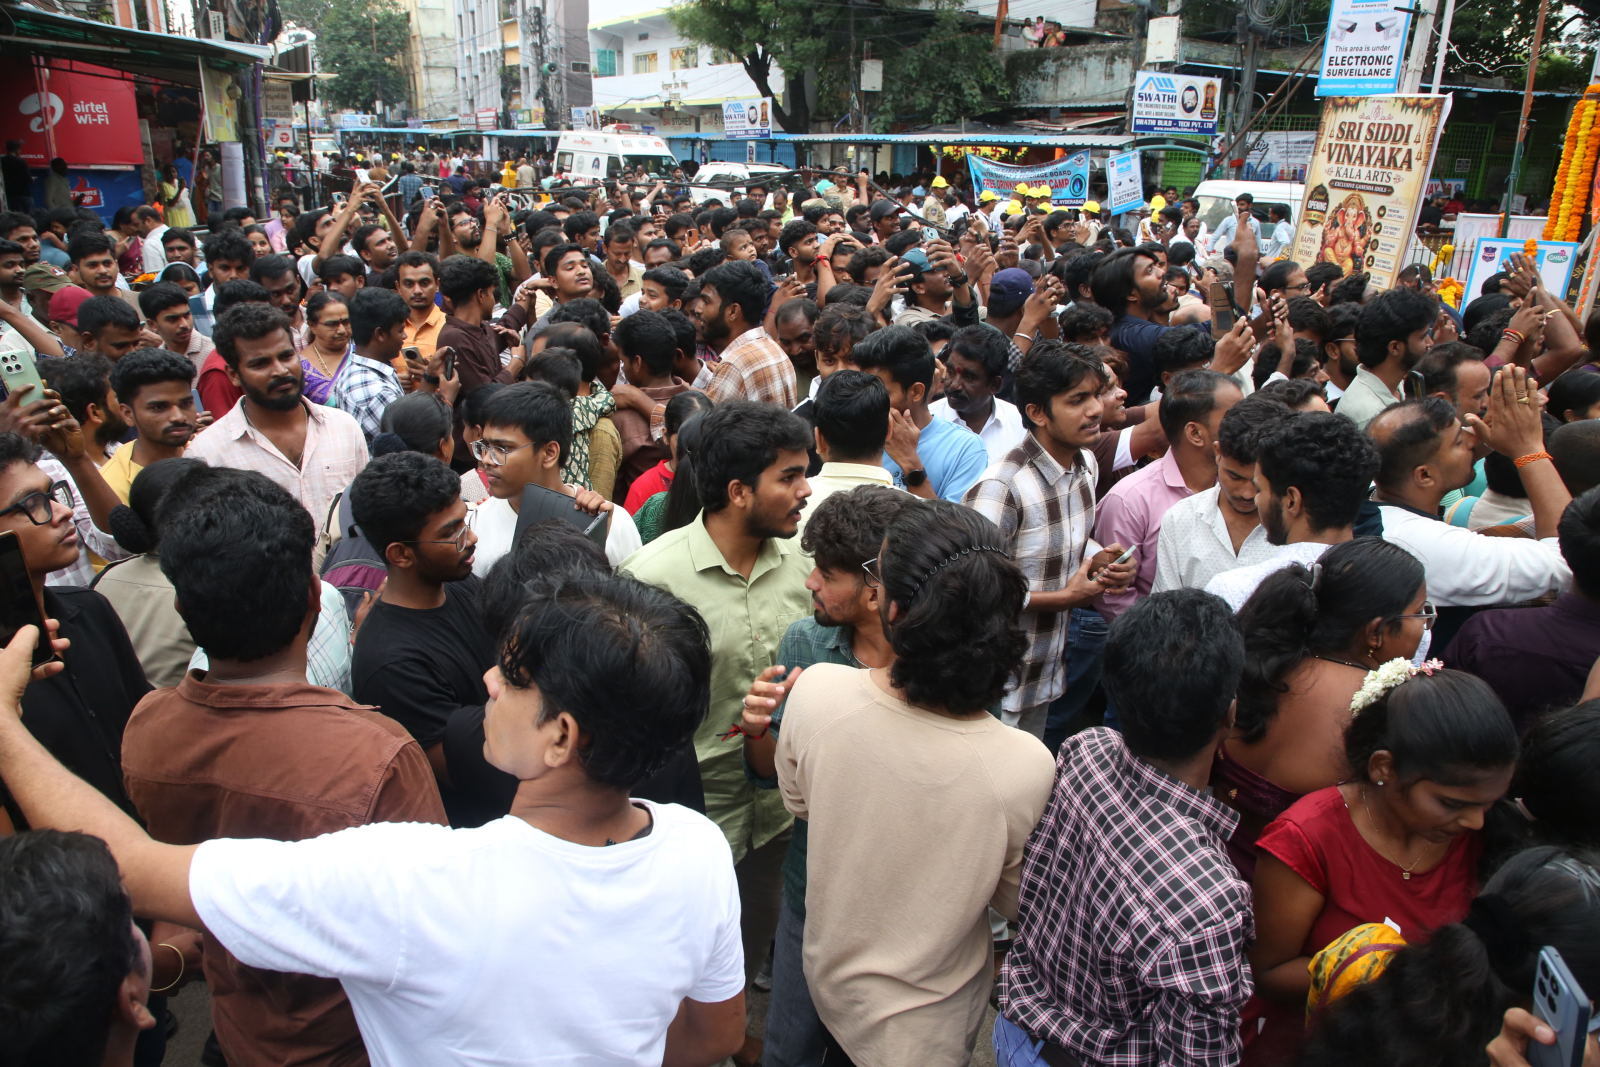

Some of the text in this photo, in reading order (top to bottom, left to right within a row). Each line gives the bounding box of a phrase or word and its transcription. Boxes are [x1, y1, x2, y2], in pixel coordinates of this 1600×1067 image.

[1328, 55, 1394, 66] ELECTRONIC
[1326, 68, 1391, 76] SURVEILLANCE
[1137, 93, 1177, 103] SWATHI
[73, 101, 108, 113] airtel
[74, 114, 110, 125] Wi-Fi
[1336, 121, 1413, 145] SRI SIDDI
[1326, 142, 1413, 171] VINAYAKA
[1335, 166, 1392, 183] KALA ARTS
[1050, 178, 1070, 189] CAMP
[1307, 200, 1328, 211] OPENING
